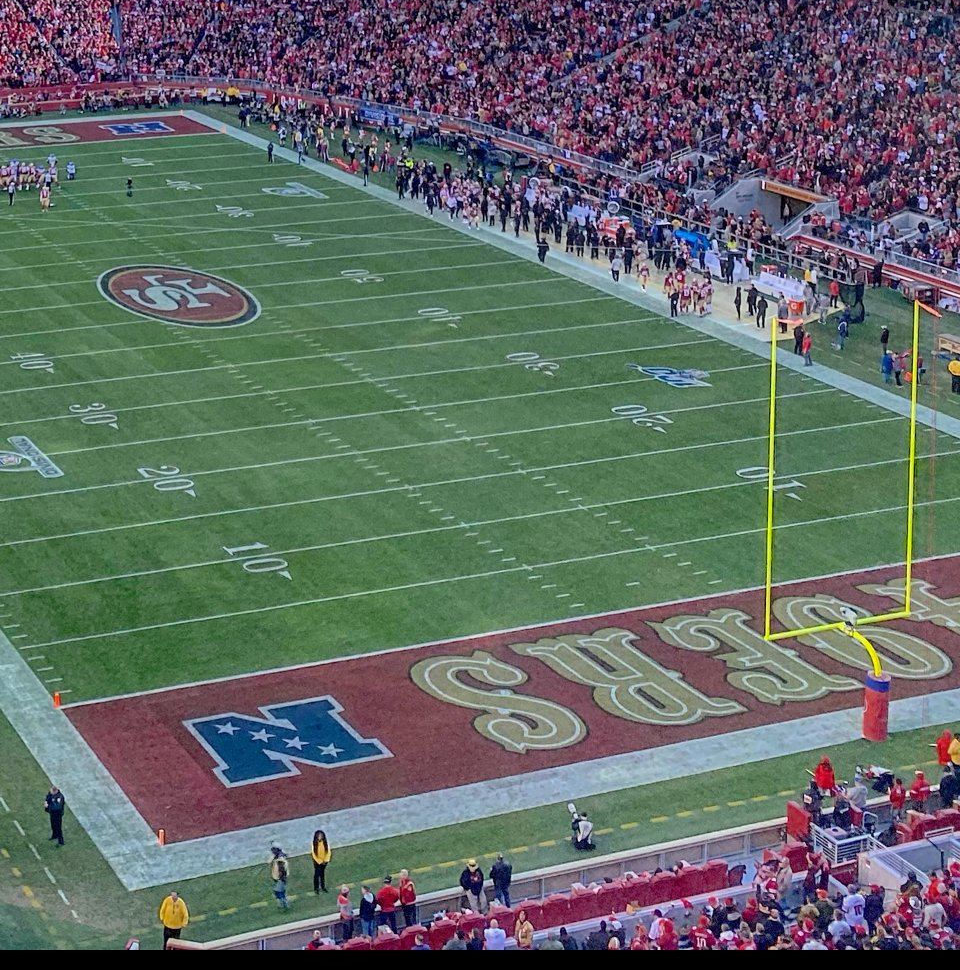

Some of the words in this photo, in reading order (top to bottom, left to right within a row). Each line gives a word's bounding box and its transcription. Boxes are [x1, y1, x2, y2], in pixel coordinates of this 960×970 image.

[10, 352, 54, 370] 40
[505, 351, 560, 374] 30
[69, 402, 119, 425] 30
[611, 403, 675, 429] 20
[137, 465, 196, 492] 20
[222, 541, 289, 573] 10
